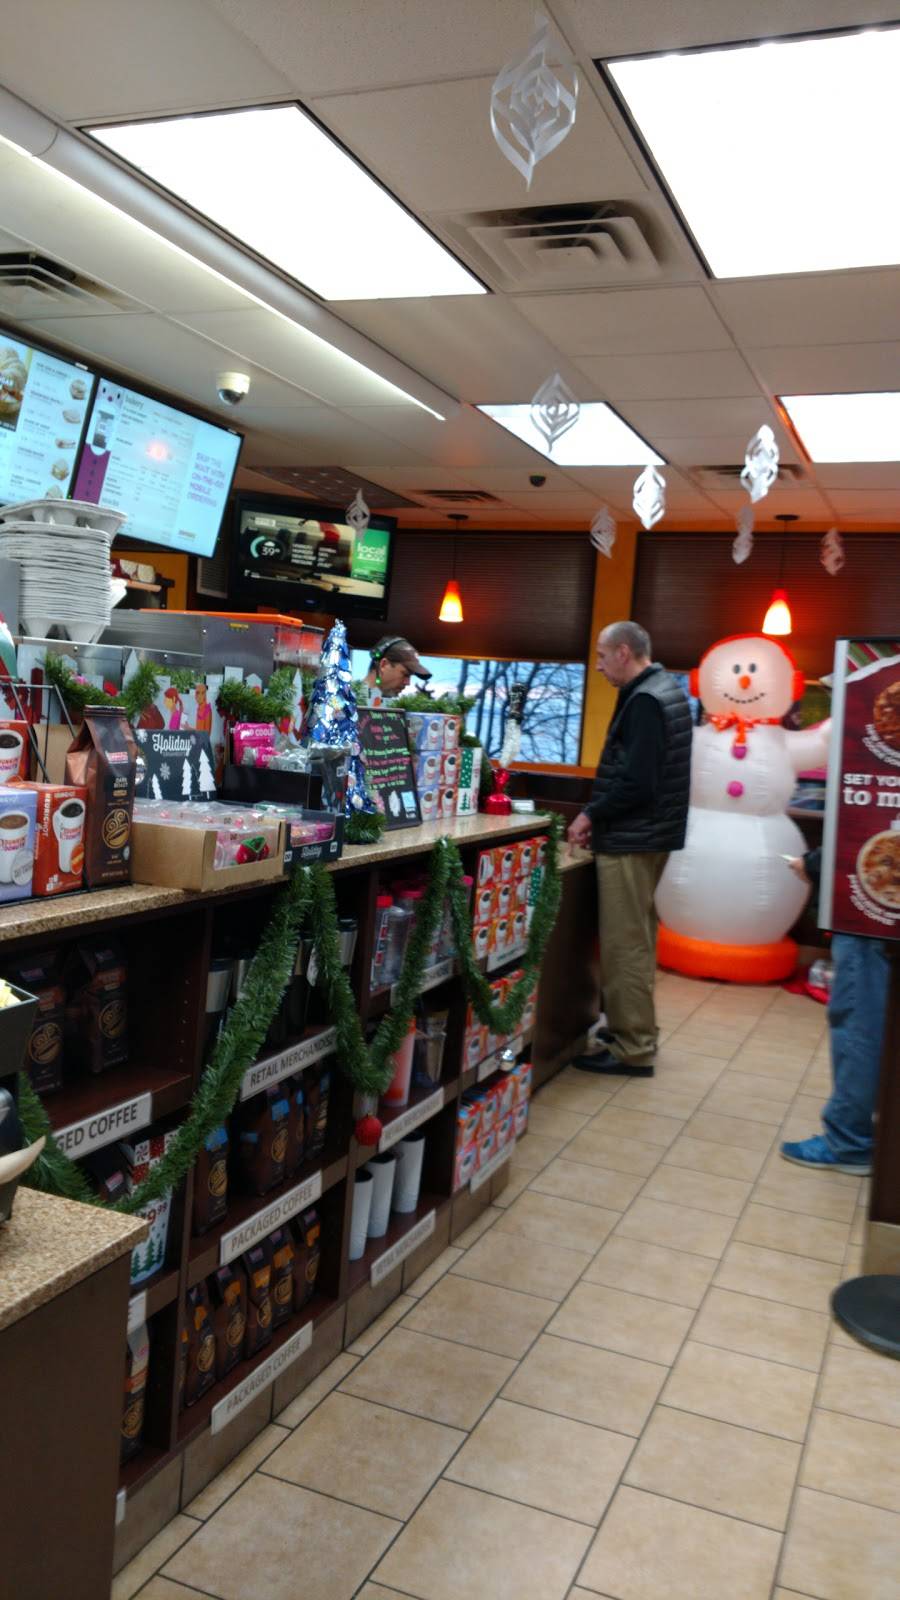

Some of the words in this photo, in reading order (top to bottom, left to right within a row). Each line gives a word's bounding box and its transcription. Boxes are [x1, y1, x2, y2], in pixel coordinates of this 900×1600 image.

[152, 733, 192, 757] Holiday
[843, 773, 871, 786] SET
[843, 786, 873, 806] to
[250, 1060, 278, 1088] RETAIL
[88, 1103, 138, 1139] COFFEE
[231, 1206, 280, 1252] PACKAGED
[282, 1184, 313, 1216] COFFEE
[226, 1364, 272, 1413] PACKAGED
[273, 1338, 301, 1371] COFFEE
